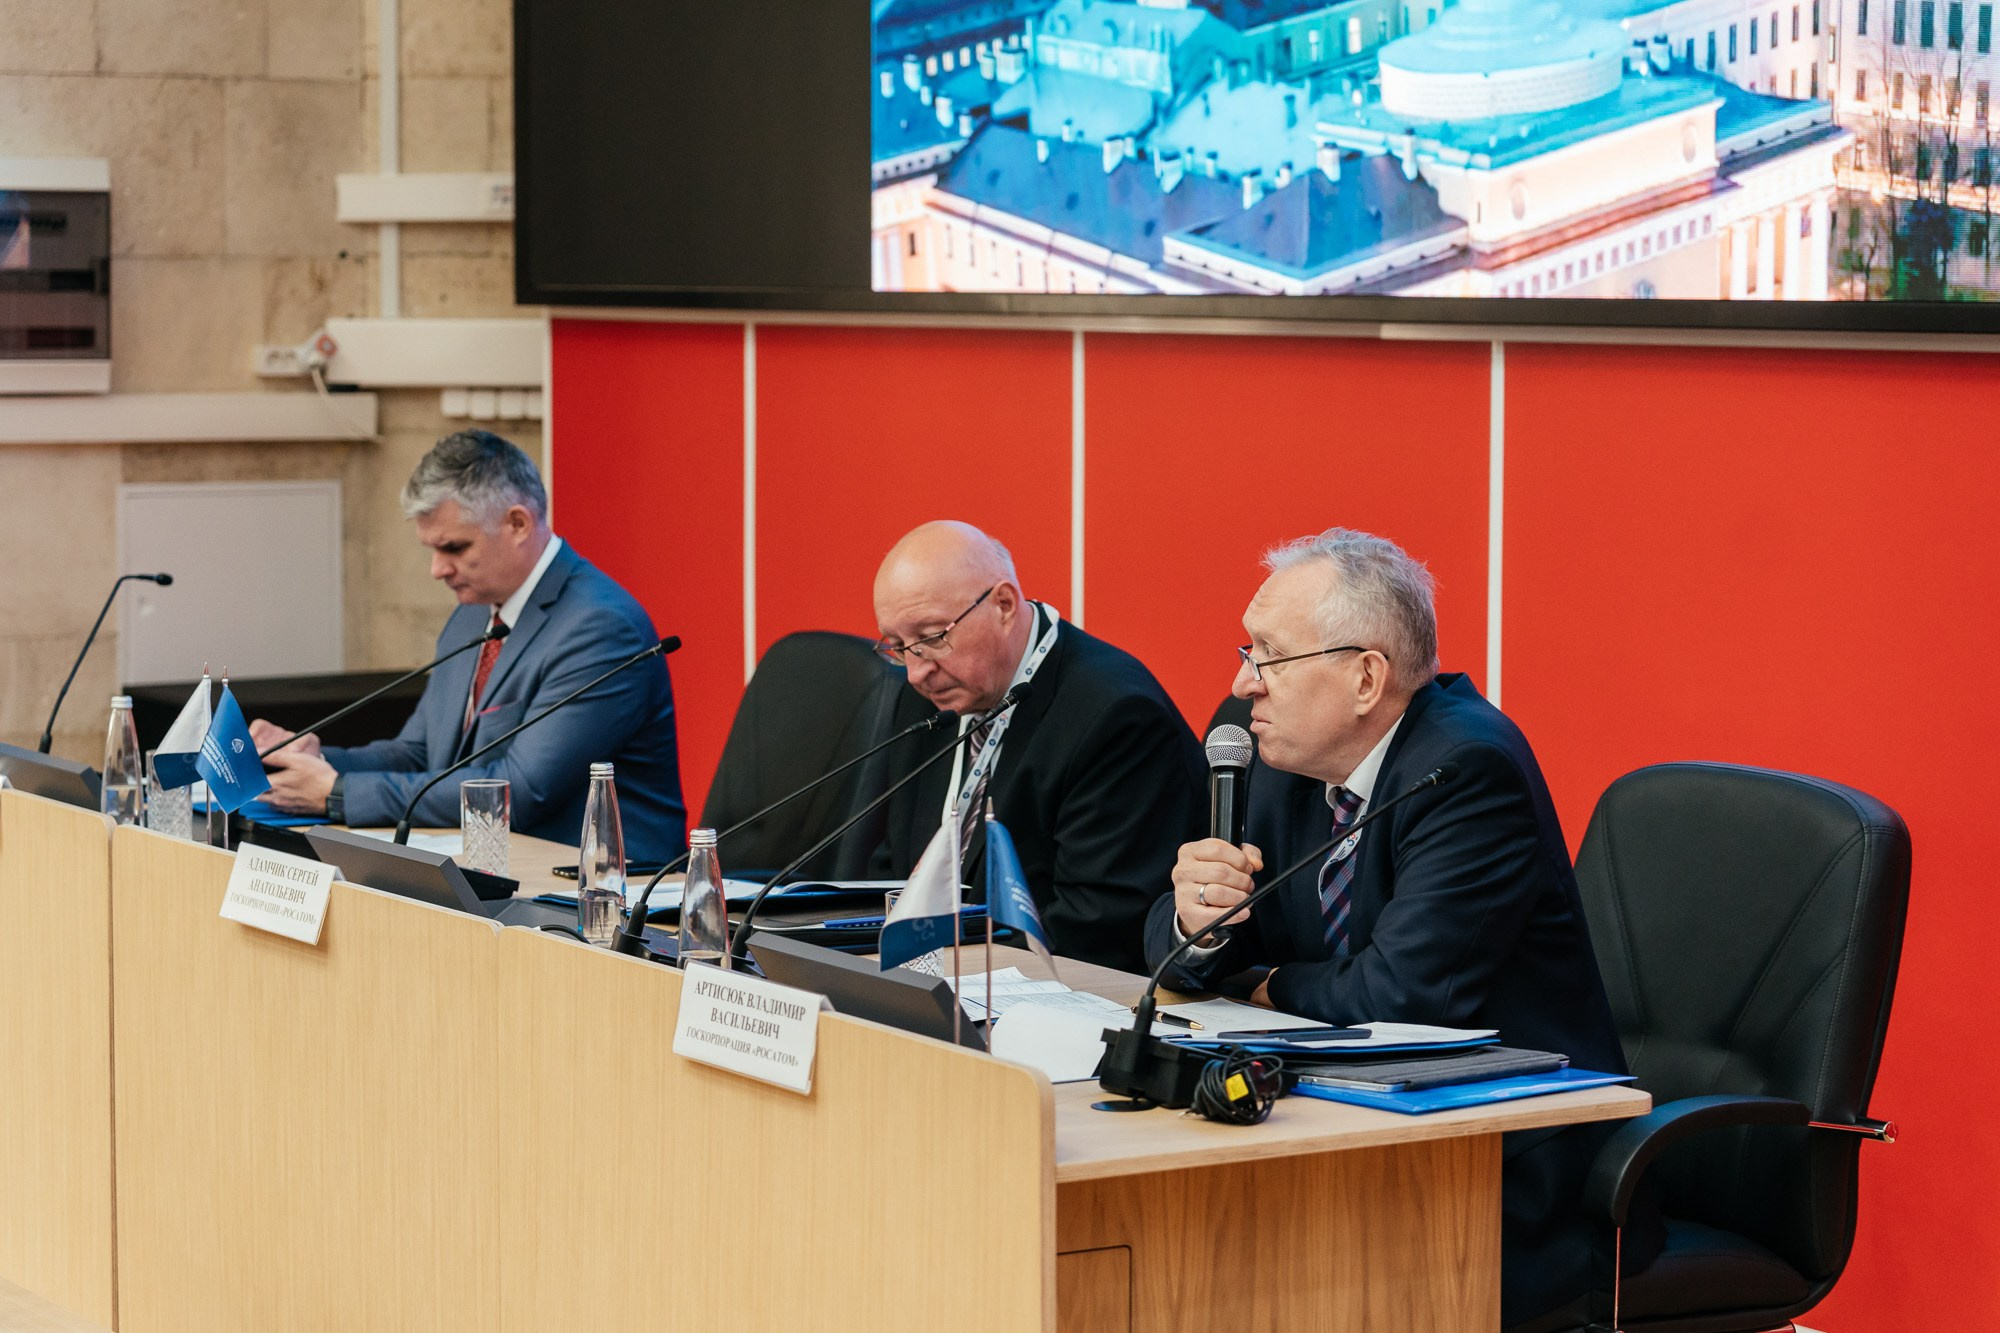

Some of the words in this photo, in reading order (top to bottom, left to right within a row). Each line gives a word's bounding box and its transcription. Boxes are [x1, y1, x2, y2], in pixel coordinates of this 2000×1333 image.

[247, 857, 287, 878] АДАМЧИК
[287, 866, 320, 887] СЕРГЕЙ
[248, 878, 307, 905] АНАТОЛЬЕВИЧ
[281, 906, 317, 925] «РОСАТОМ»
[694, 980, 746, 1006] АРТИСЮК
[746, 993, 806, 1021] ВЛАДИМИР
[710, 1007, 780, 1040] ВАСИЛЬЕВИЧ
[686, 1026, 751, 1054] ГОСКОРПОРАЦИЯ
[751, 1046, 799, 1067] «РОСАТОМ»
